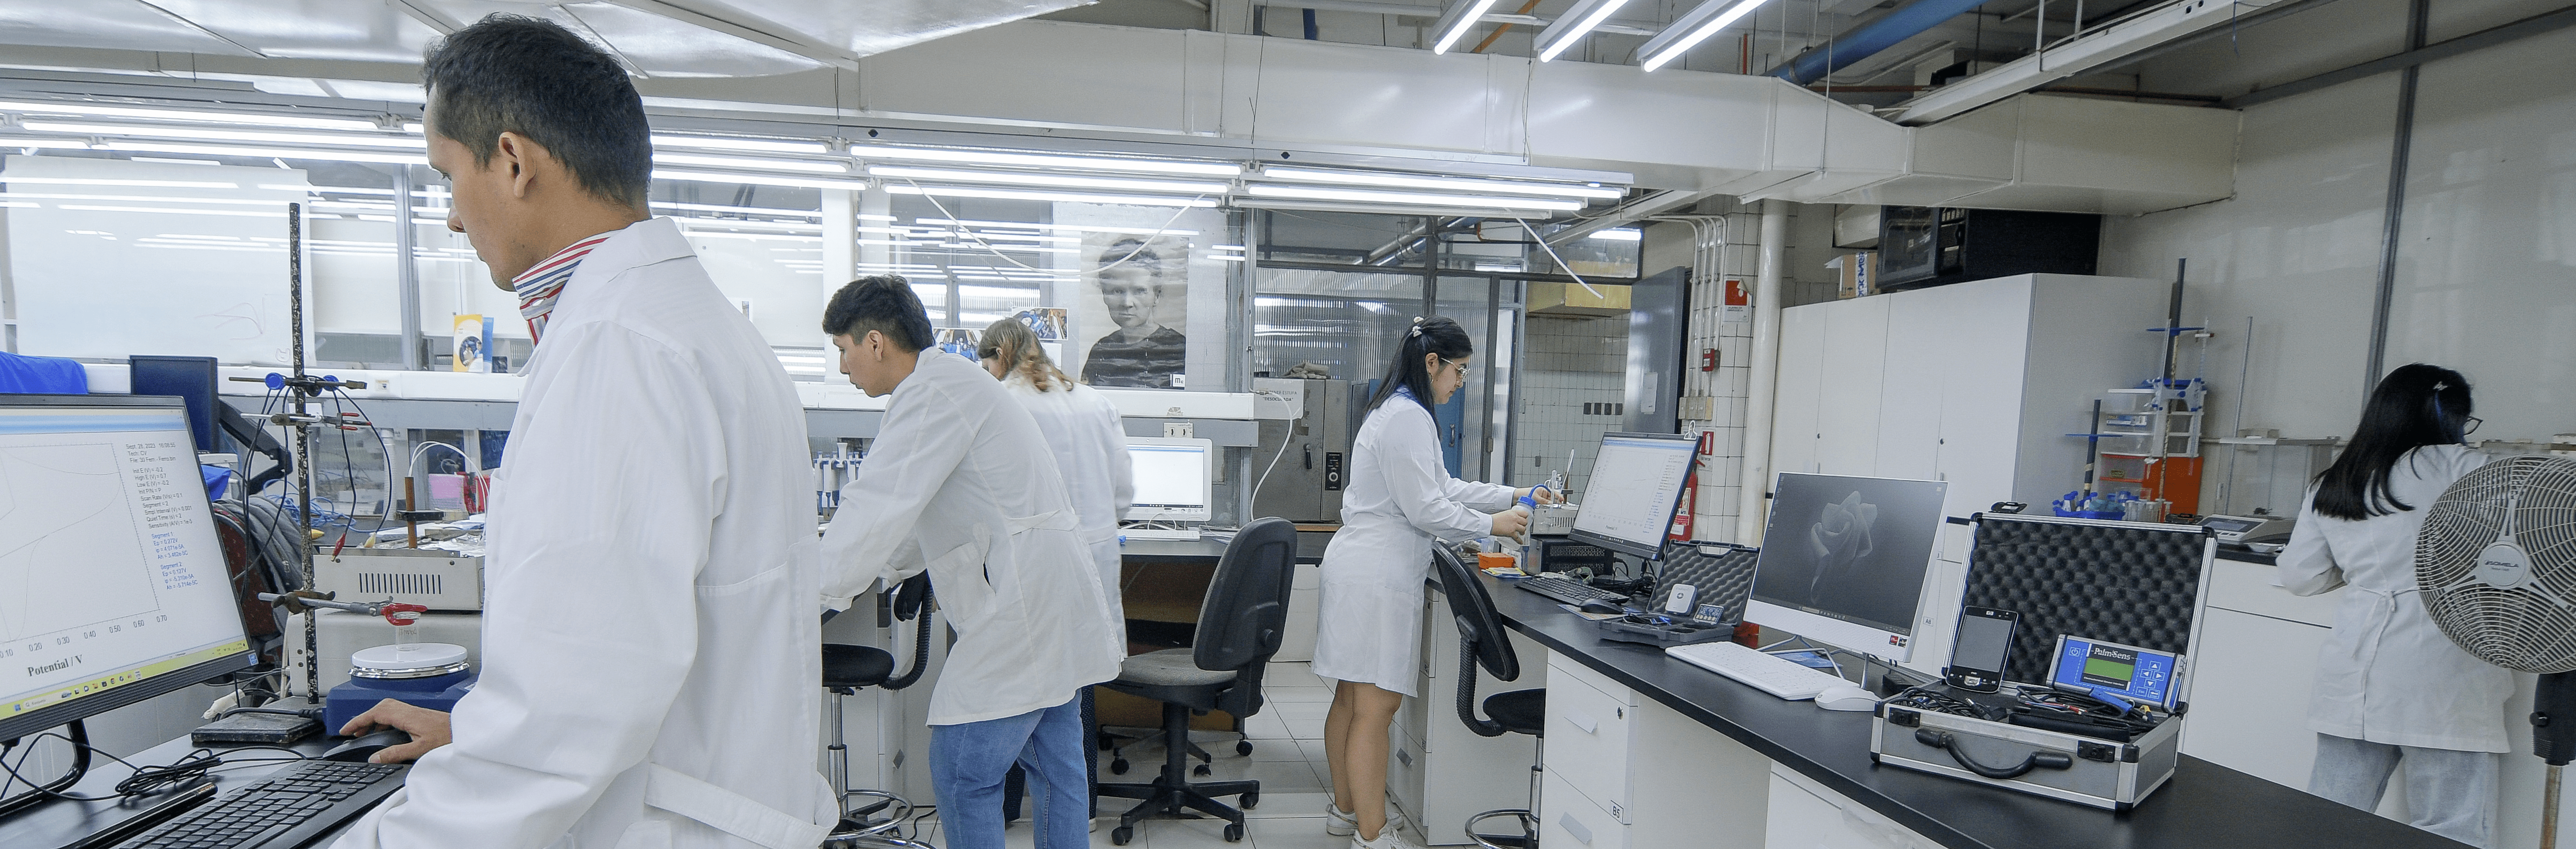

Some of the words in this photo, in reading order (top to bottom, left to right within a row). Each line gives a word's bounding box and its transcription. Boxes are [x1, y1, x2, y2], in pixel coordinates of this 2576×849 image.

[28, 642, 43, 652] 0.20
[57, 636, 70, 646] 0.30
[84, 630, 97, 640] 0.40
[109, 625, 121, 633] 0.50
[133, 620, 145, 628] 0.60
[156, 614, 168, 623] 0.70
[27, 657, 69, 677] Potential
[71, 656, 74, 666] /
[75, 654, 83, 664] V
[1612, 805, 1620, 818] B5
